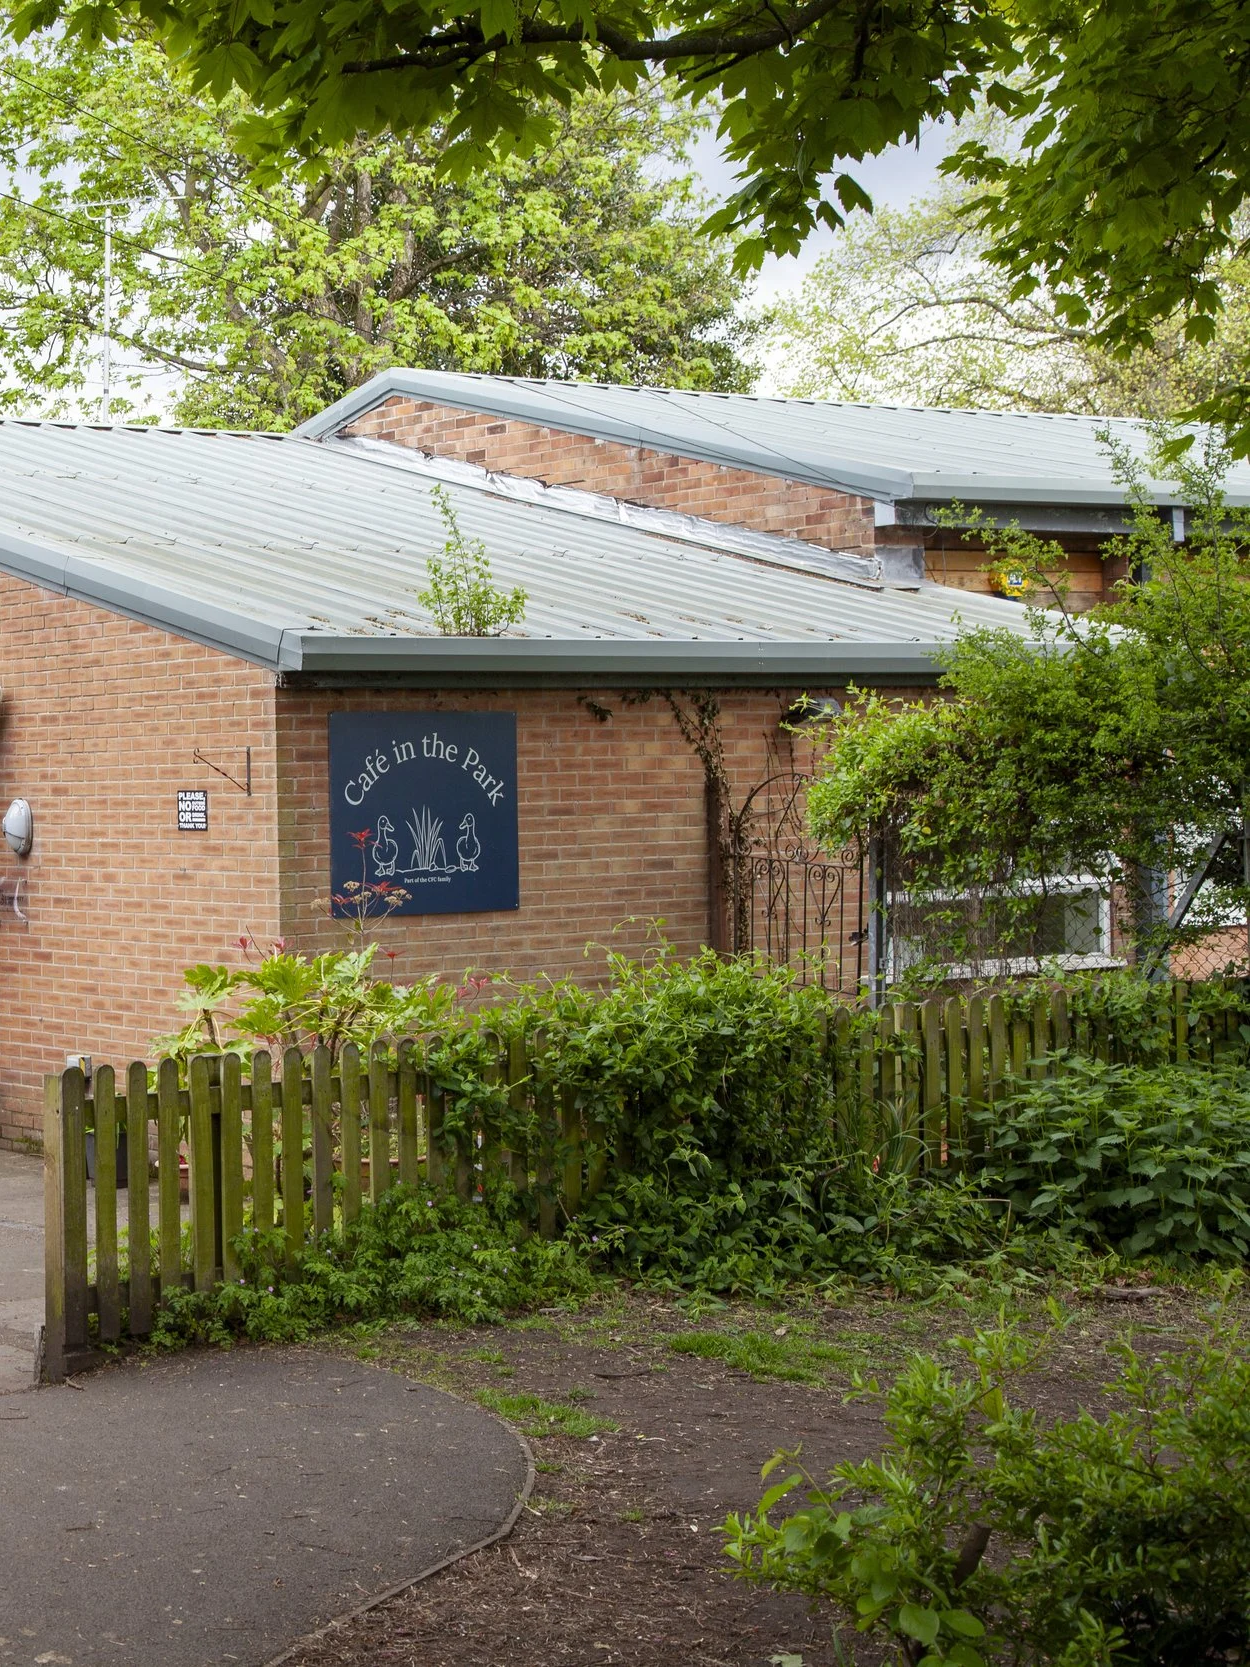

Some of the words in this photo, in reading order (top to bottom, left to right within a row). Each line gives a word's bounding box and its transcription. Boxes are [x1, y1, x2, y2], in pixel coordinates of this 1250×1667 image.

[344, 749, 390, 806] Café
[392, 739, 417, 765] in
[422, 732, 458, 763] the
[461, 747, 504, 807] Park
[179, 800, 192, 811] NO
[179, 812, 192, 823] OR
